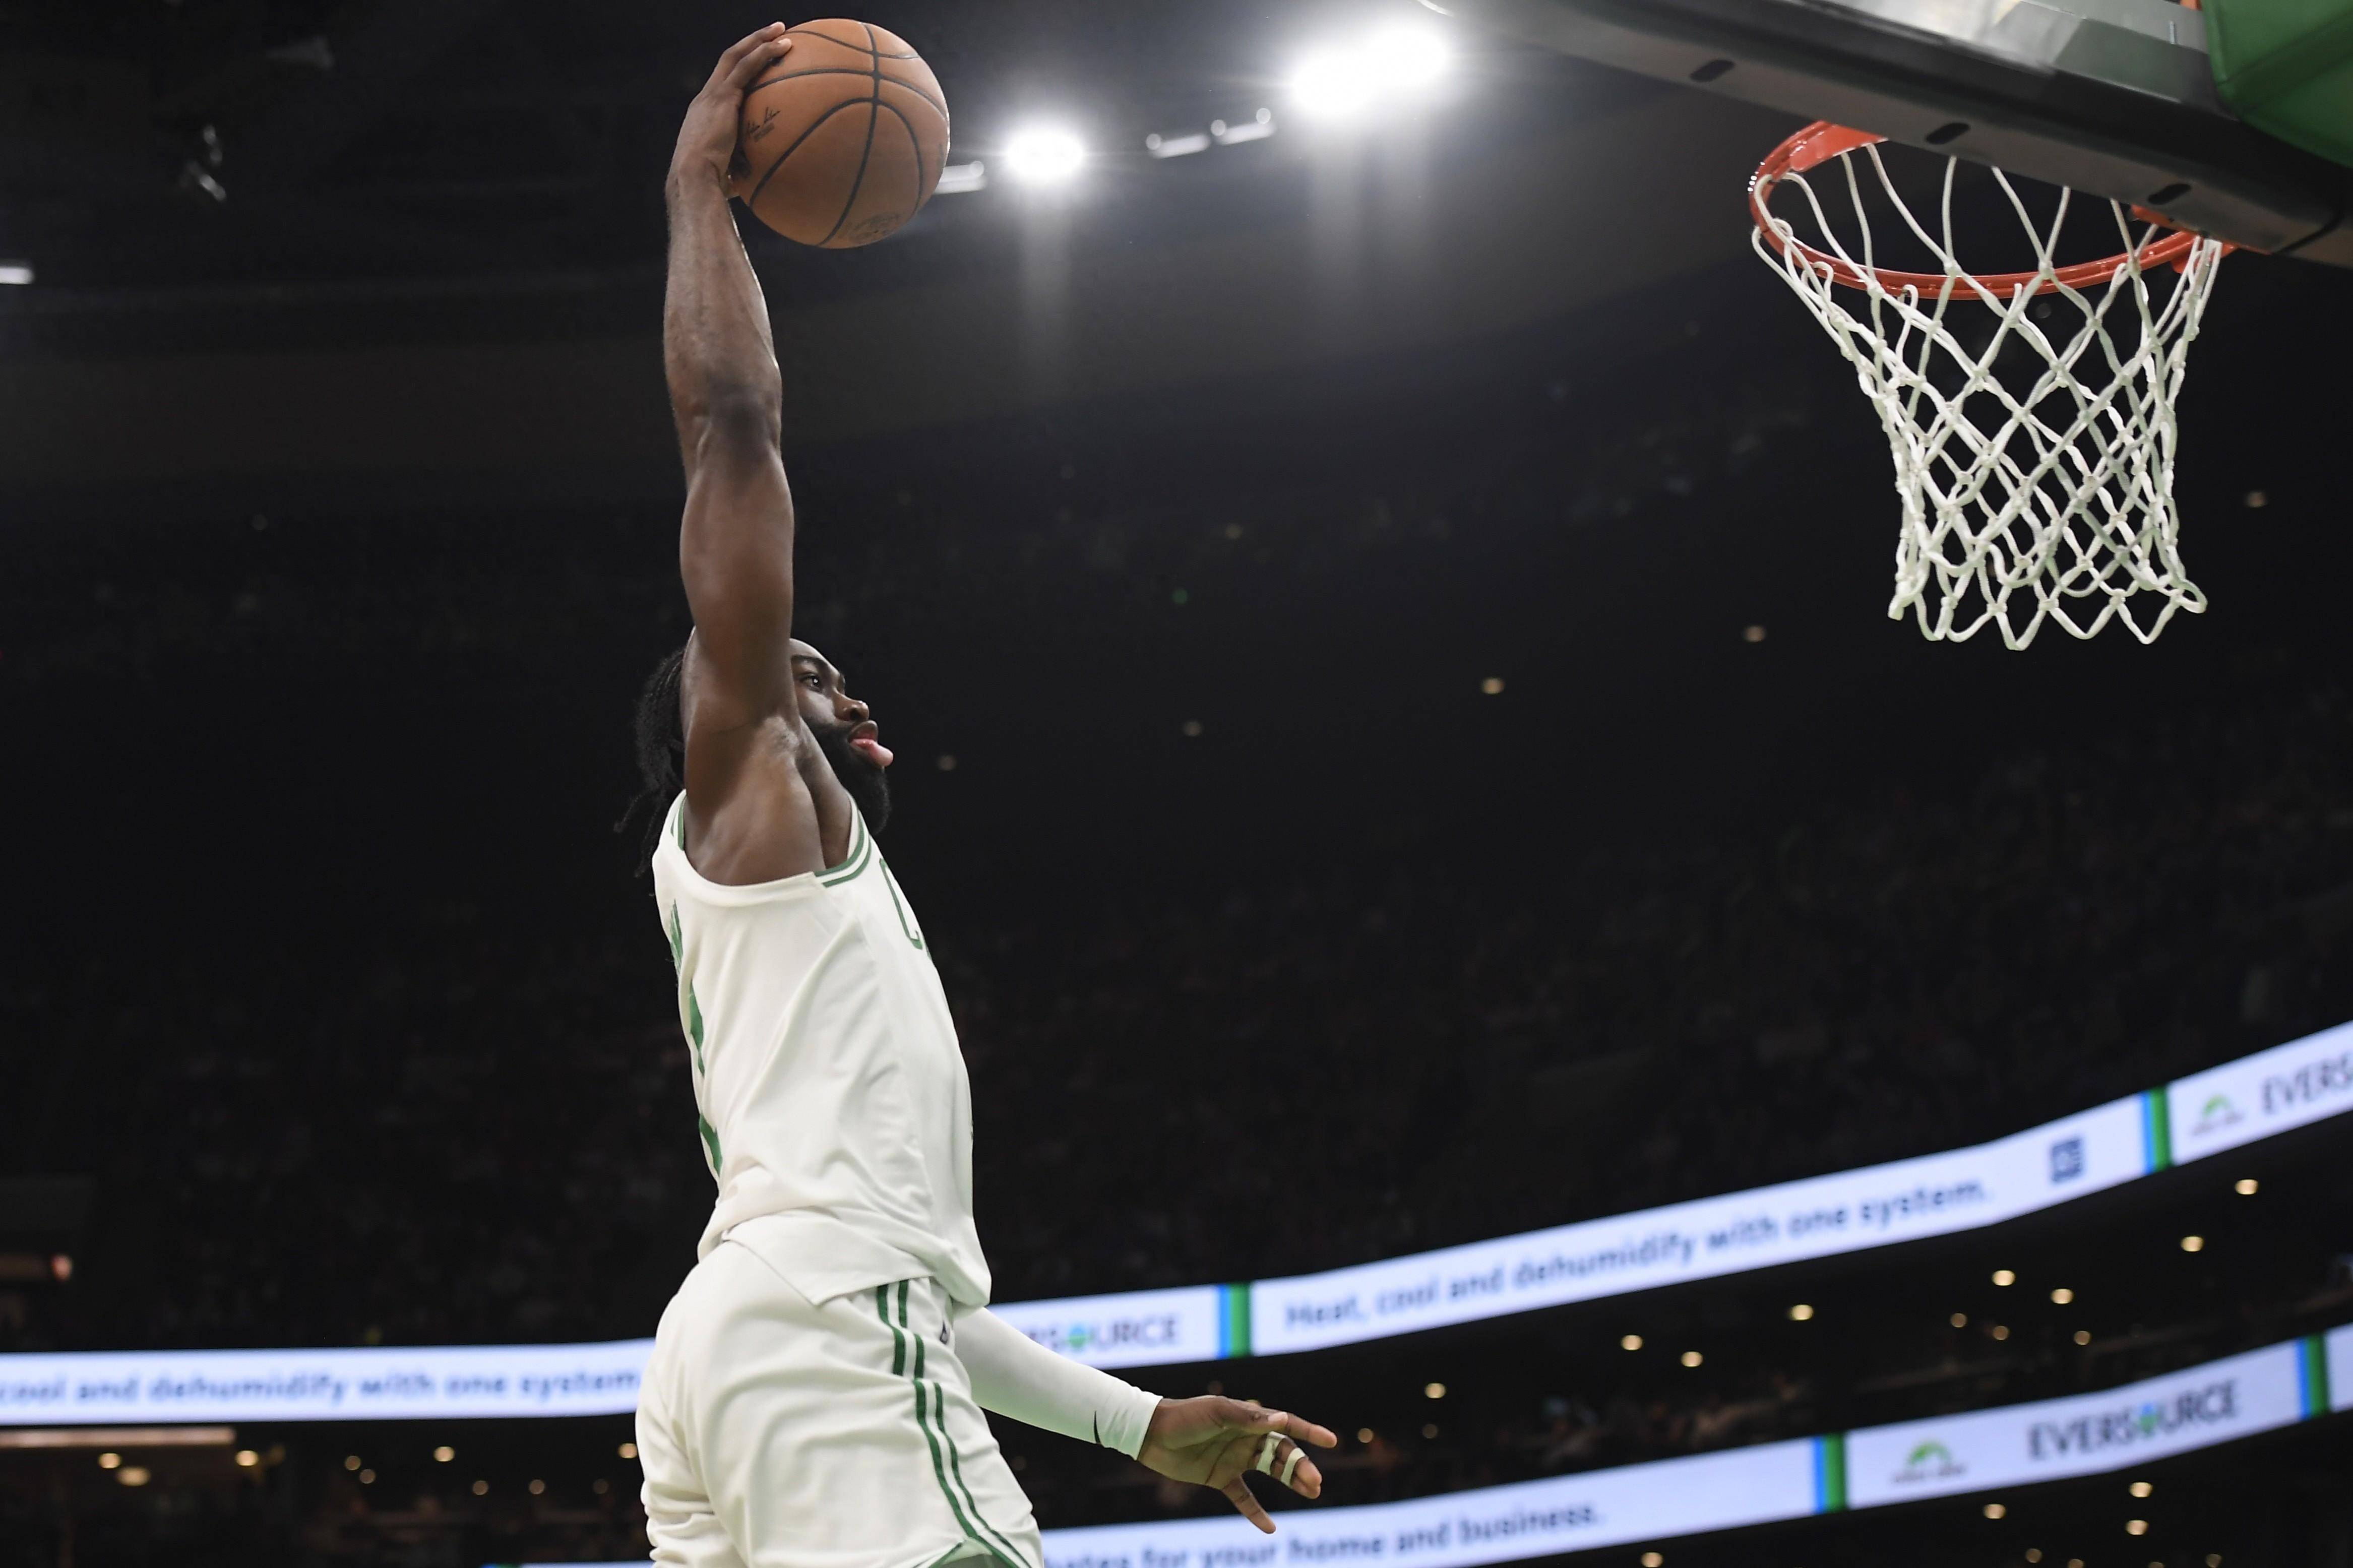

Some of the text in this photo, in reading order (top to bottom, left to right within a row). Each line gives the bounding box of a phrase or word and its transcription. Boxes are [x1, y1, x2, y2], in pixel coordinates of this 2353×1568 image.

[1449, 1265, 1504, 1299] and
[1706, 1215, 1778, 1251] with
[1788, 1208, 1845, 1238] one
[358, 1368, 435, 1399] with
[446, 1373, 506, 1398] one
[1286, 1530, 1385, 1559] home
[1396, 1520, 1452, 1552] and
